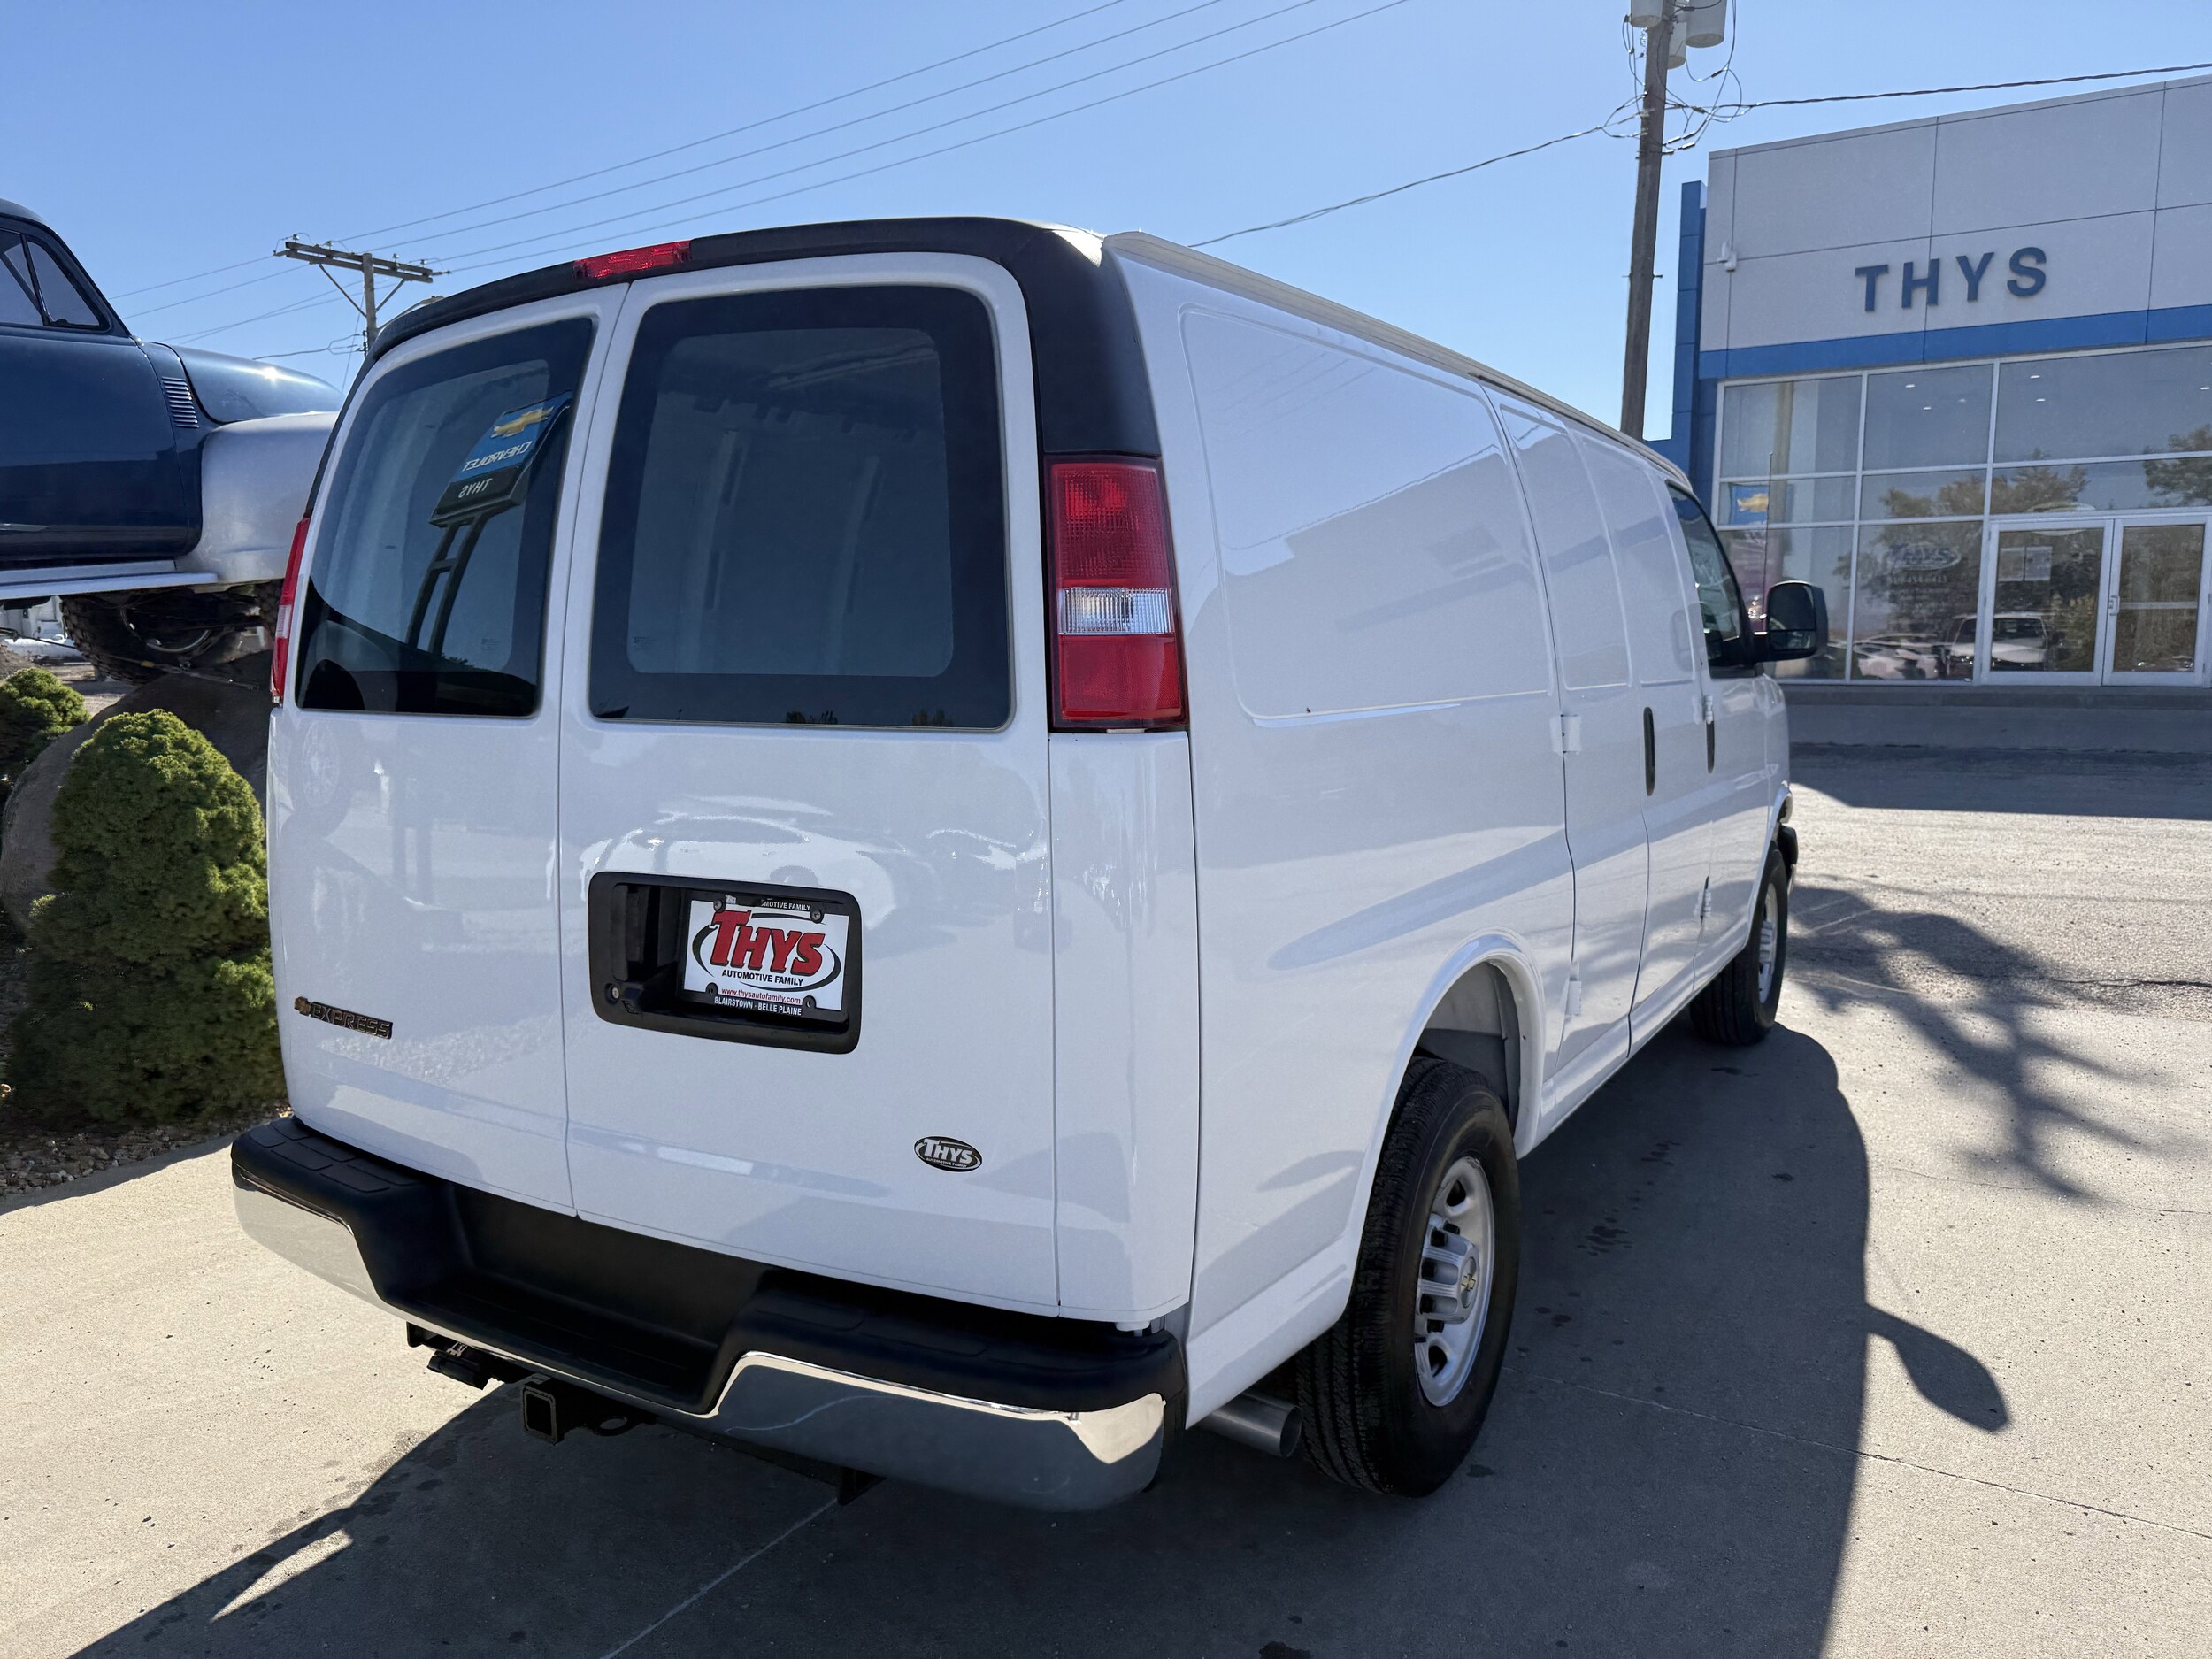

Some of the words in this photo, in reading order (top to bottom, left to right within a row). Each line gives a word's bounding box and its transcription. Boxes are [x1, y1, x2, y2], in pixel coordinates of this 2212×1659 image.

[1855, 246, 2047, 311] THYS
[788, 902, 810, 911] FAMILY
[710, 910, 826, 977] THYS
[722, 970, 772, 983] AUTOMOTIVE
[774, 976, 803, 987] FAMILY
[714, 996, 753, 1010] BLAIRSTOWN
[757, 1002, 778, 1013] BELLE
[779, 1006, 802, 1016] PLAINE
[721, 987, 801, 1004] www.thysautofamily.com
[311, 1002, 391, 1039] EXPRESS
[923, 1138, 973, 1164] THYS
